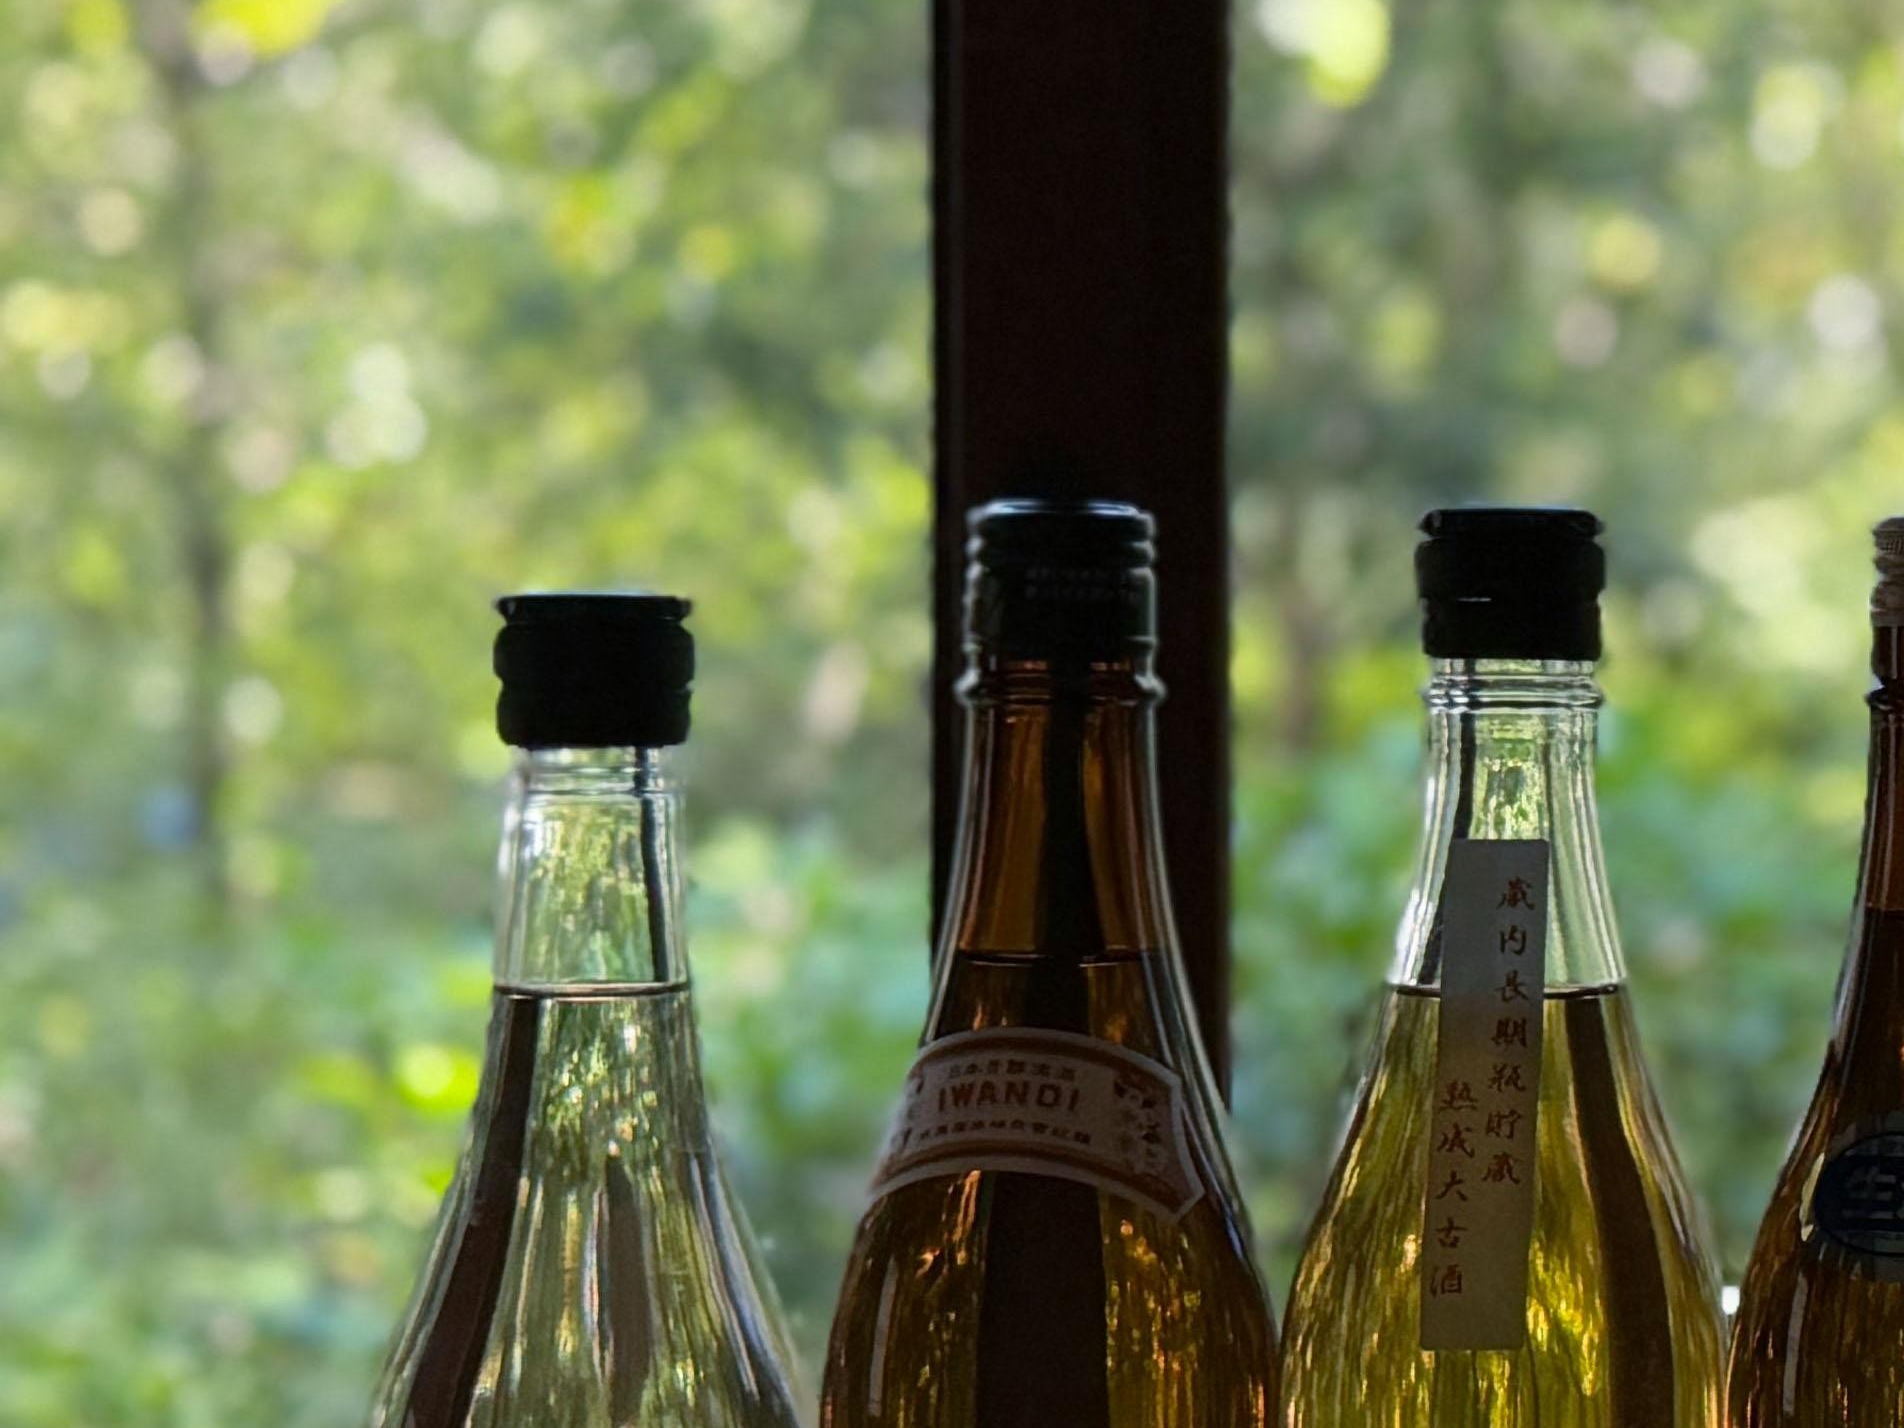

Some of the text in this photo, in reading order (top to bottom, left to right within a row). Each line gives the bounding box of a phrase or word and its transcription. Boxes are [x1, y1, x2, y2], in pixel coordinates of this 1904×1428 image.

[1480, 875, 1537, 1187] 蔵内長期瓶貯蔵
[1428, 1077, 1480, 1298] 熟成大古酒
